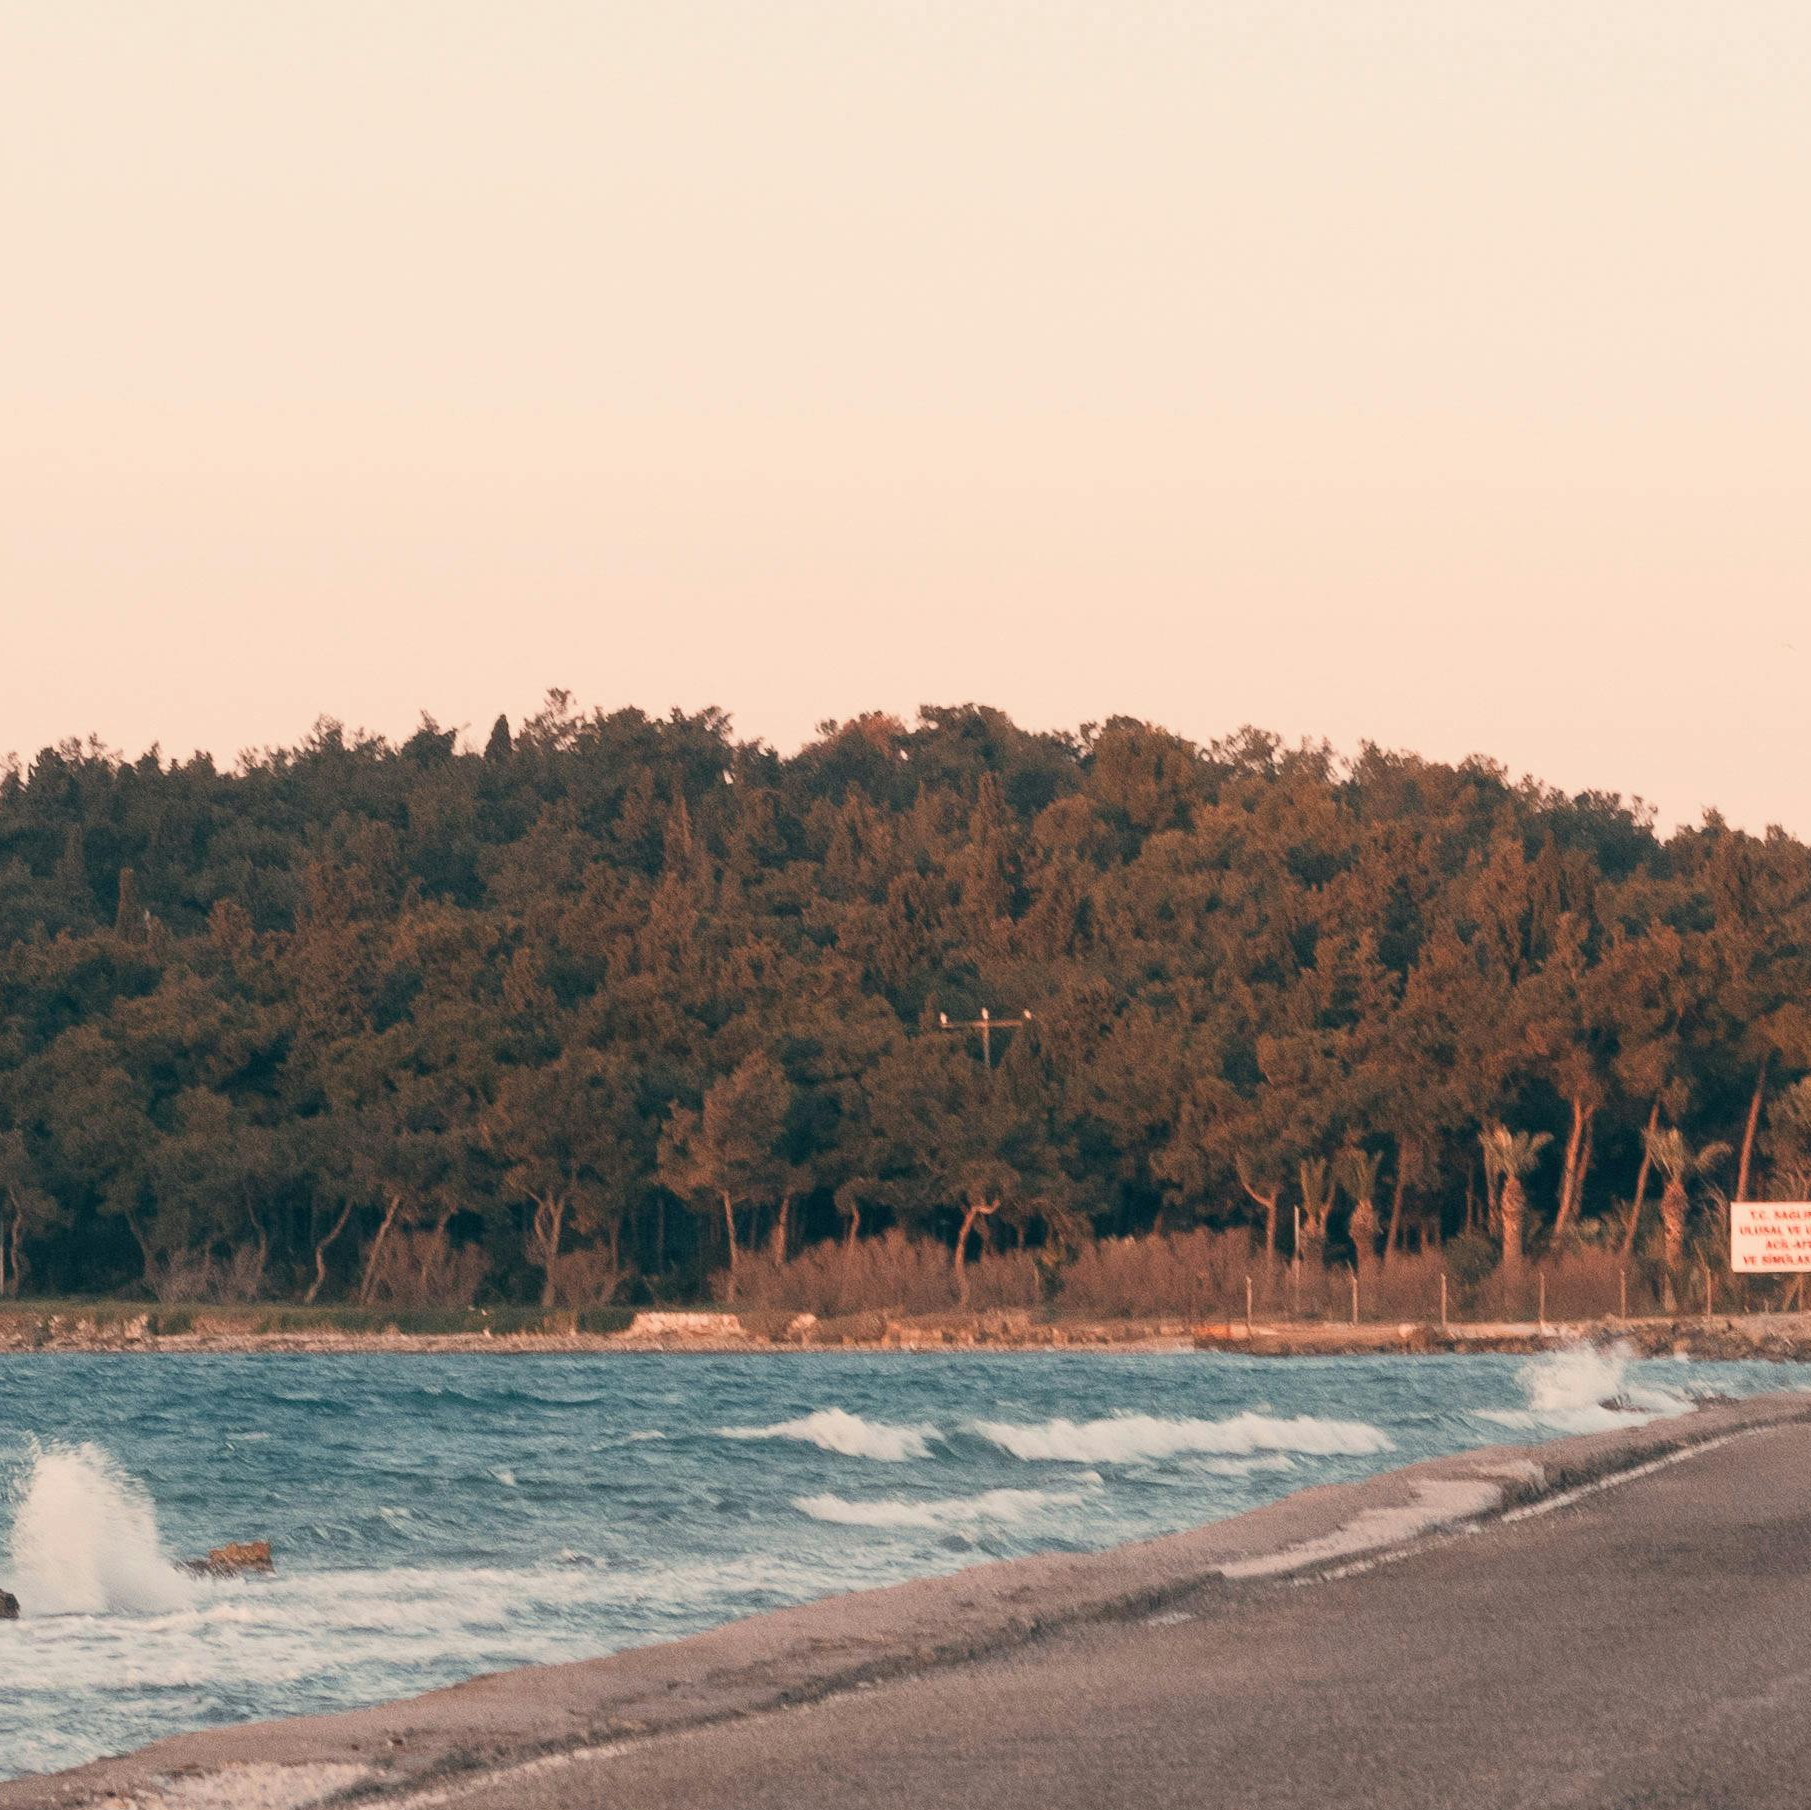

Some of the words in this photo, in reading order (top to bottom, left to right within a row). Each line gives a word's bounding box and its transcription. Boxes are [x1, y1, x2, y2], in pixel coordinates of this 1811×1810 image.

[1740, 1225, 1782, 1235] ULUSAL
[1787, 1225, 1801, 1235] VE
[1743, 1255, 1757, 1265] VE
